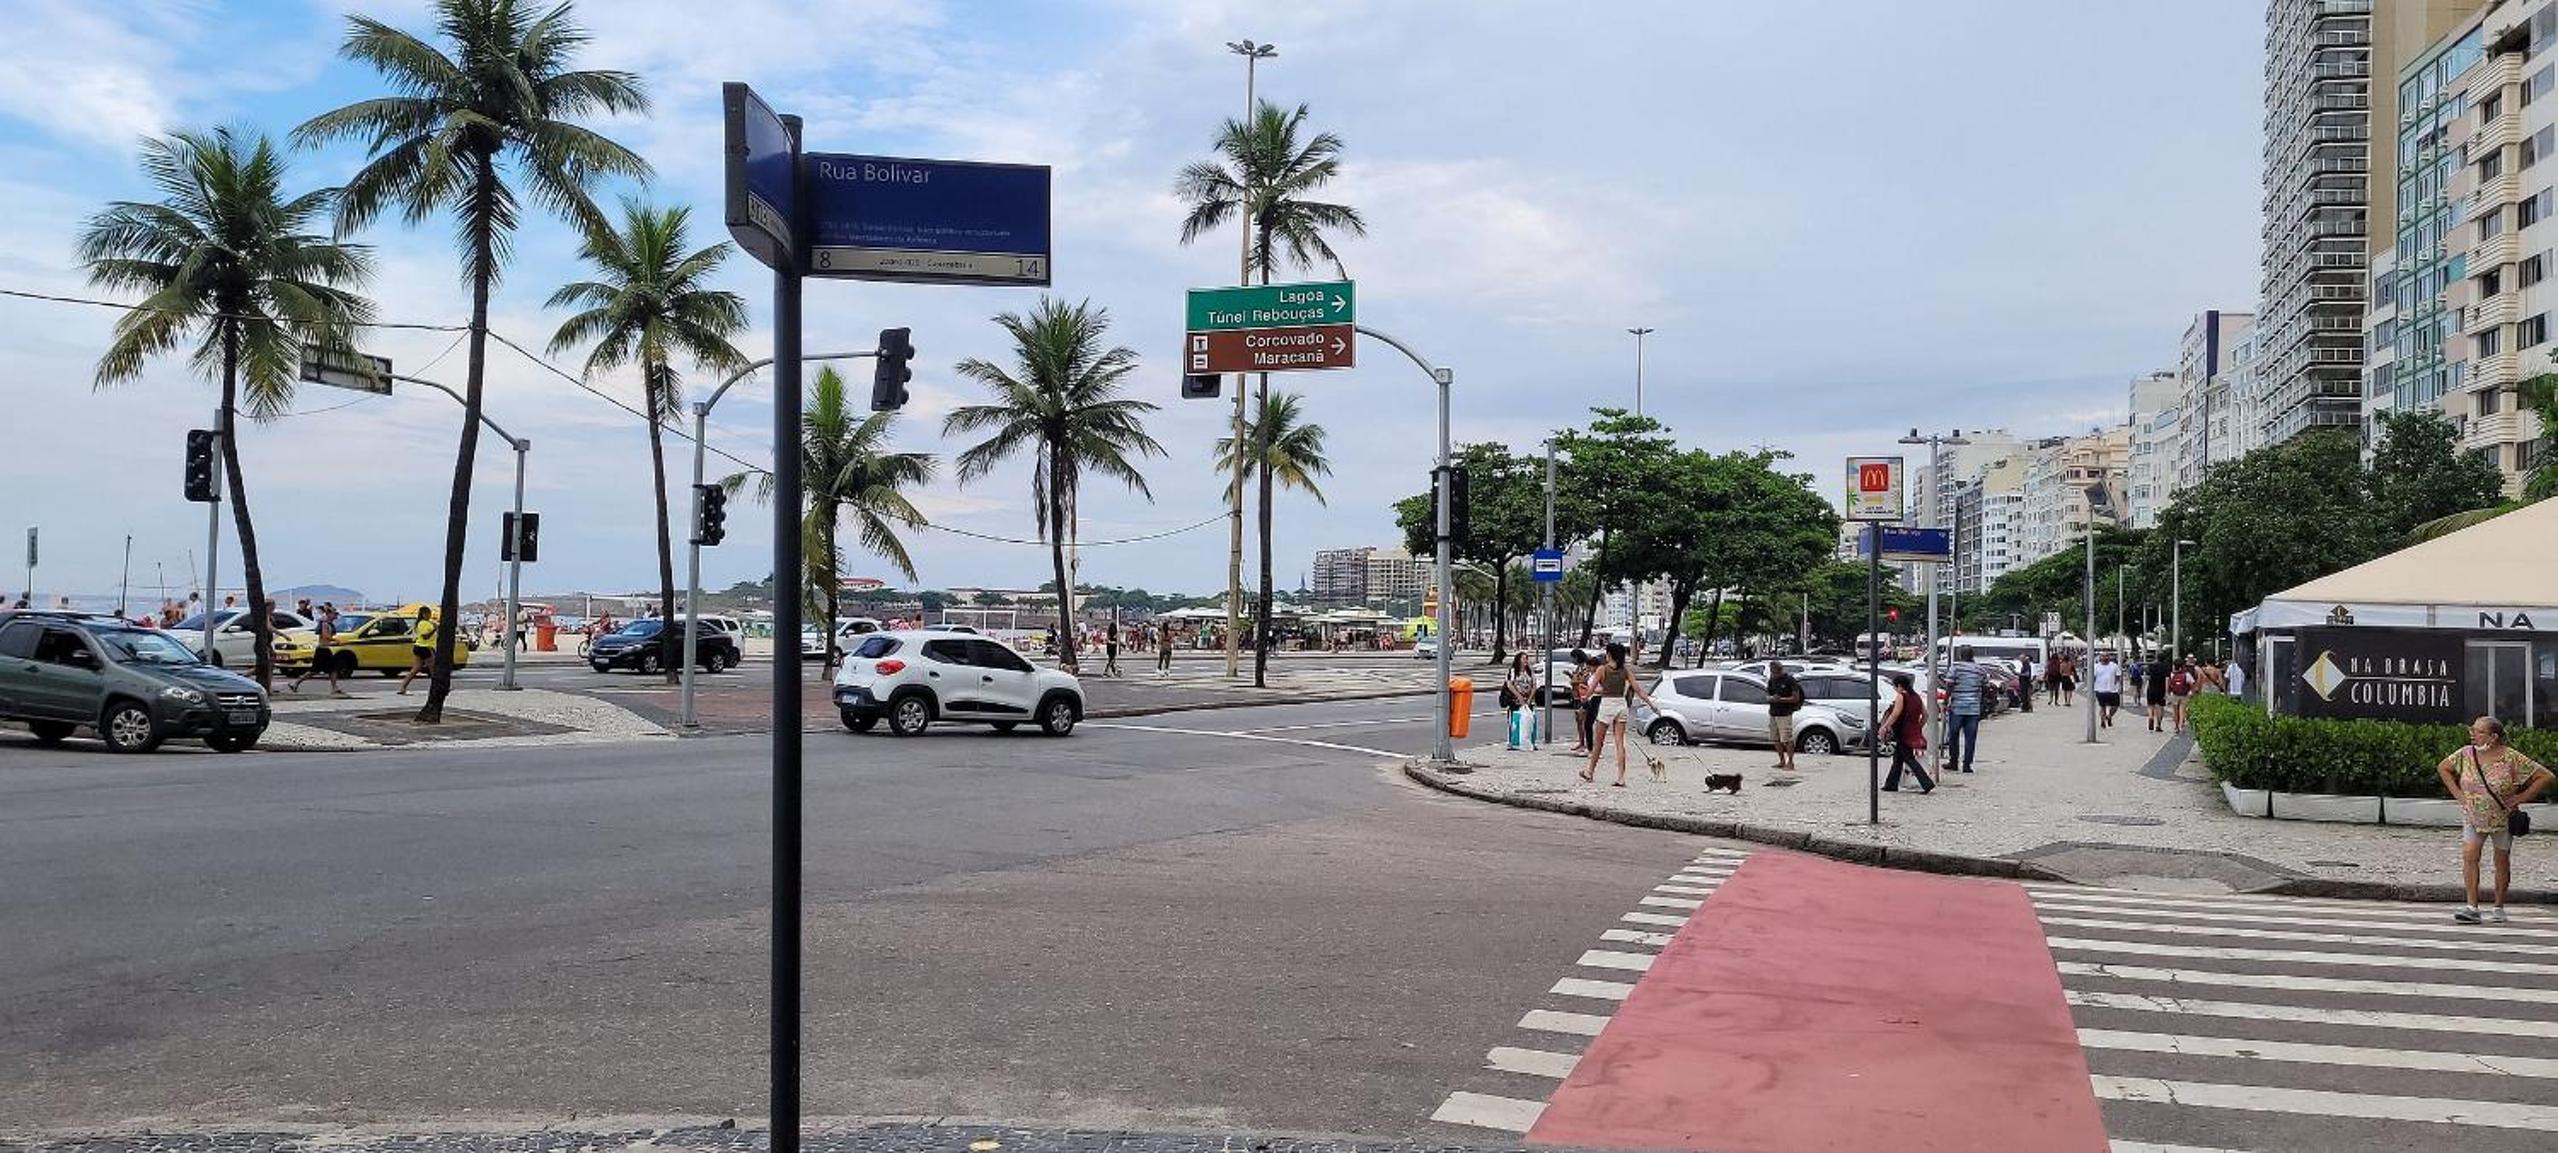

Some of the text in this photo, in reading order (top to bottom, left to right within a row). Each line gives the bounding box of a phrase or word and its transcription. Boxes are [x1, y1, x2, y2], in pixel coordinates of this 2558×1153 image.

[820, 161, 857, 180] Rua
[820, 251, 1040, 278] 8 14
[1279, 290, 1324, 305] Lagoa
[1208, 307, 1324, 324] Túnel Rebouças
[1245, 332, 1324, 347] Corcovado
[1254, 349, 1324, 365] Maracanã
[2479, 611, 2535, 630] NA
[2351, 657, 2447, 676] NA BRASA
[2351, 681, 2450, 707] COLUMBIA
